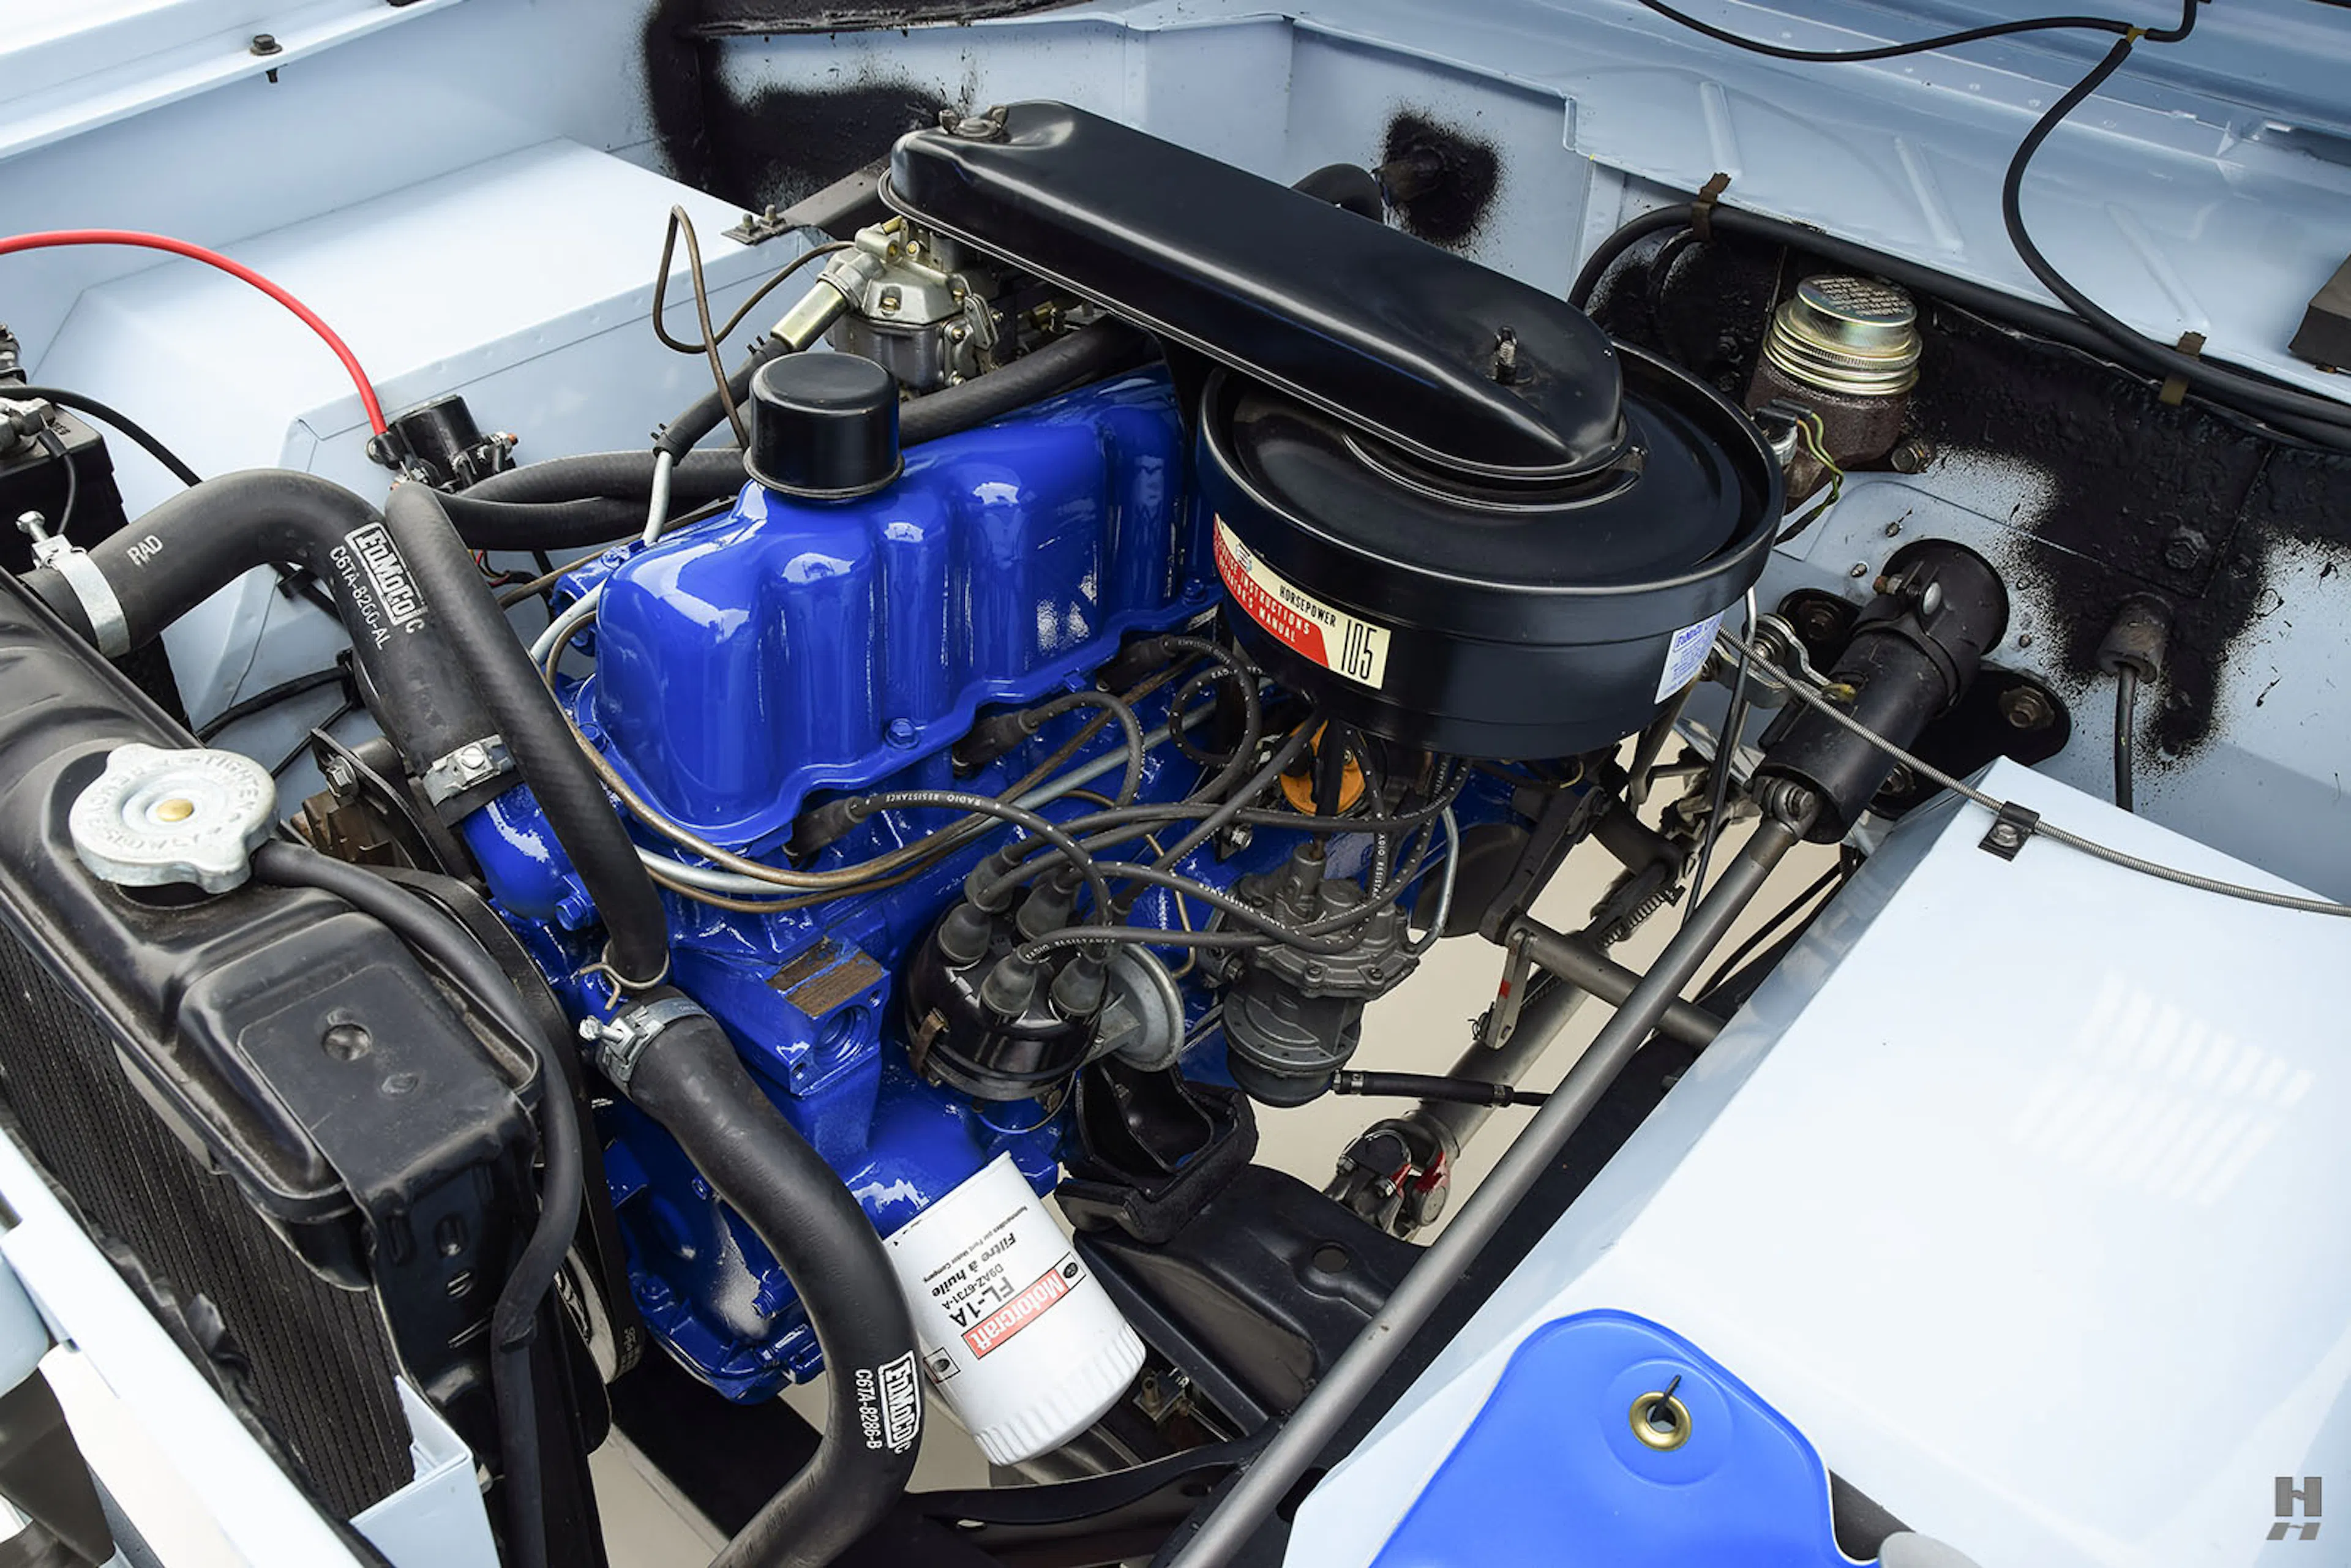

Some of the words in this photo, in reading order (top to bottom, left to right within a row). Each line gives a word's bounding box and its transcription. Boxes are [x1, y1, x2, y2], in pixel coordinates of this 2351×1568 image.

[127, 535, 163, 566] RAD
[1241, 570, 1310, 635] INSTRUCTIONS
[1280, 585, 1337, 627] HORSEPOWER
[1259, 607, 1295, 642] MANUAL
[1341, 620, 1377, 680] 105
[885, 793, 939, 803] RESISTANCE
[947, 793, 983, 806] RADIO
[968, 1259, 980, 1273] à
[981, 1232, 1017, 1262] Filtre
[932, 1269, 969, 1297] huile
[941, 1262, 1005, 1310] D9AZ-6731-A
[949, 1277, 1016, 1328] FL-1A
[969, 1274, 1065, 1351] Motorcraft
[855, 1368, 883, 1449] C6TA-8286-B
